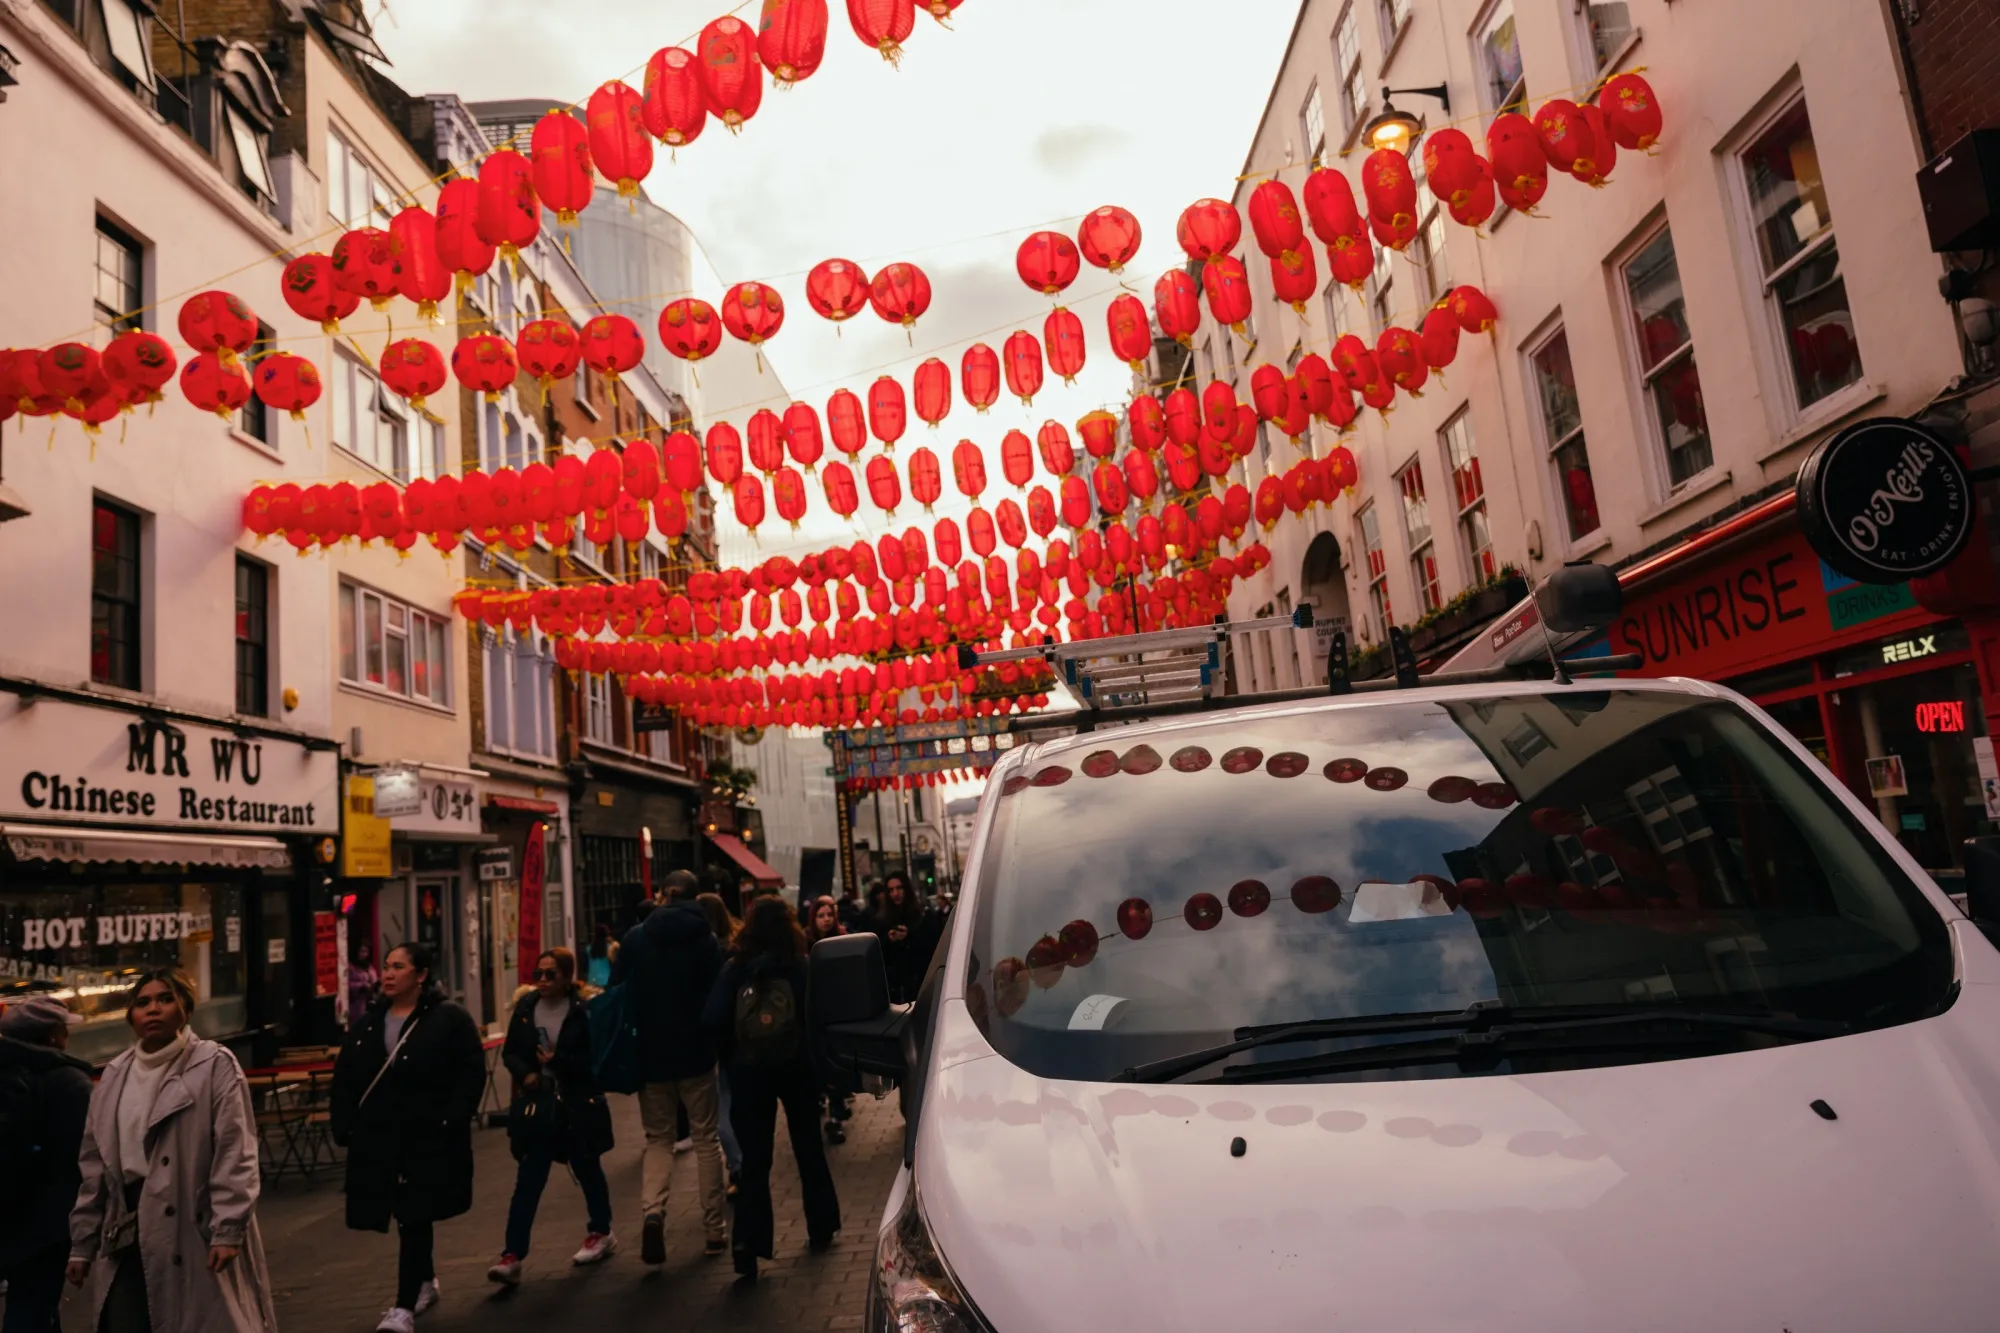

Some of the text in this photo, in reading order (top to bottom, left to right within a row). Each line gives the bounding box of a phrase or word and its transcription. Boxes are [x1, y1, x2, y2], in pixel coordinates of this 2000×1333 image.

[1849, 441, 1934, 552] O'Neill's
[1880, 463, 1959, 561] EAT DRINK ENJOY
[1314, 616, 1346, 629] RUPERT
[1621, 552, 1806, 669] SUNRISE
[1836, 586, 1900, 620] DRINKS
[1882, 635, 1937, 664] RELX
[1915, 701, 1965, 732] OPEN
[126, 723, 262, 786] MR WU
[21, 770, 156, 817] Chinese
[178, 787, 315, 825] Restaurant
[22, 917, 86, 951] HOT
[96, 912, 193, 946] BUFFET
